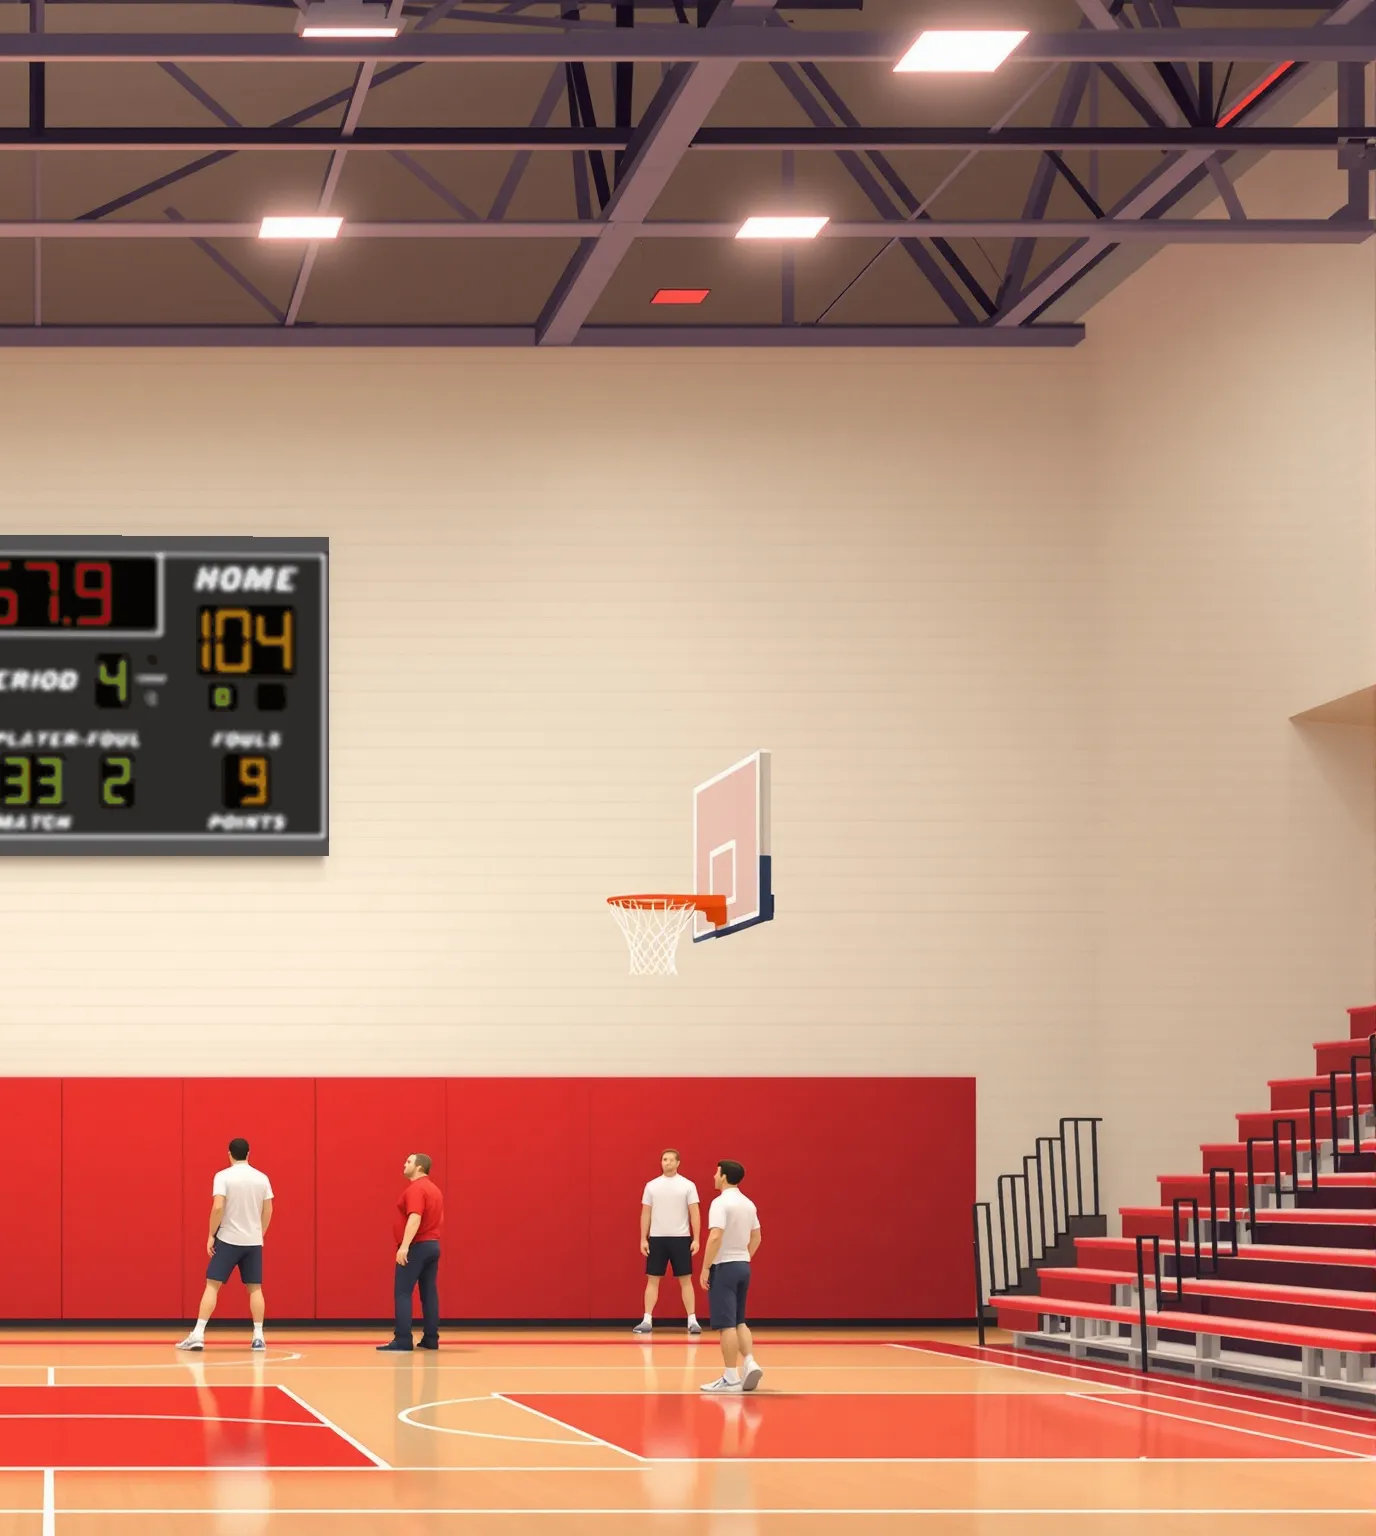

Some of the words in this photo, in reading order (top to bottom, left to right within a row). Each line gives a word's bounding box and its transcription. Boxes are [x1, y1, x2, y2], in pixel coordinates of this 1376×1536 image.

[195, 565, 298, 592] HOME
[201, 608, 292, 673] 104
[99, 660, 126, 701] 4
[4, 757, 62, 804] 33
[103, 757, 131, 804] 2
[239, 757, 267, 805] 9
[207, 814, 286, 830] POINTS
